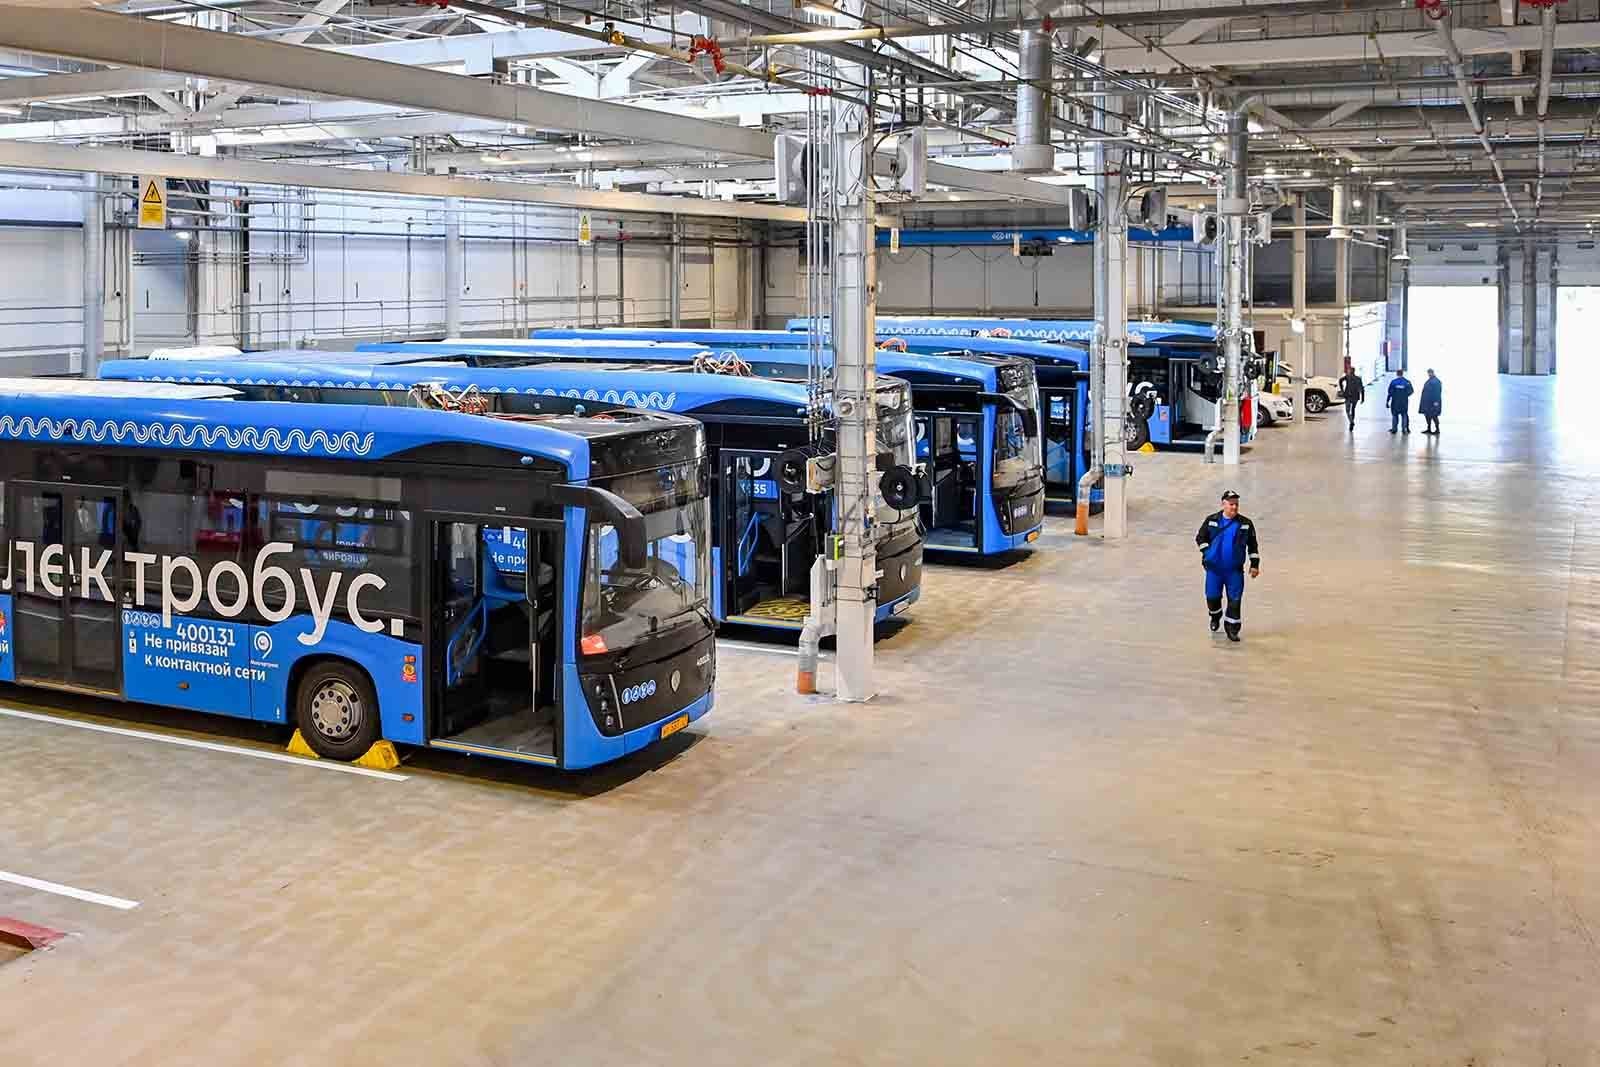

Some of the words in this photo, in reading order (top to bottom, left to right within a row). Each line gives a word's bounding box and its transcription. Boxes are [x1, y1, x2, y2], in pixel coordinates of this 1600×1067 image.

[144, 632, 163, 648] Не
[166, 639, 228, 657] привязан
[176, 623, 235, 646] 400131
[144, 654, 153, 666] к
[156, 655, 231, 677] контактной
[235, 667, 266, 681] сети
